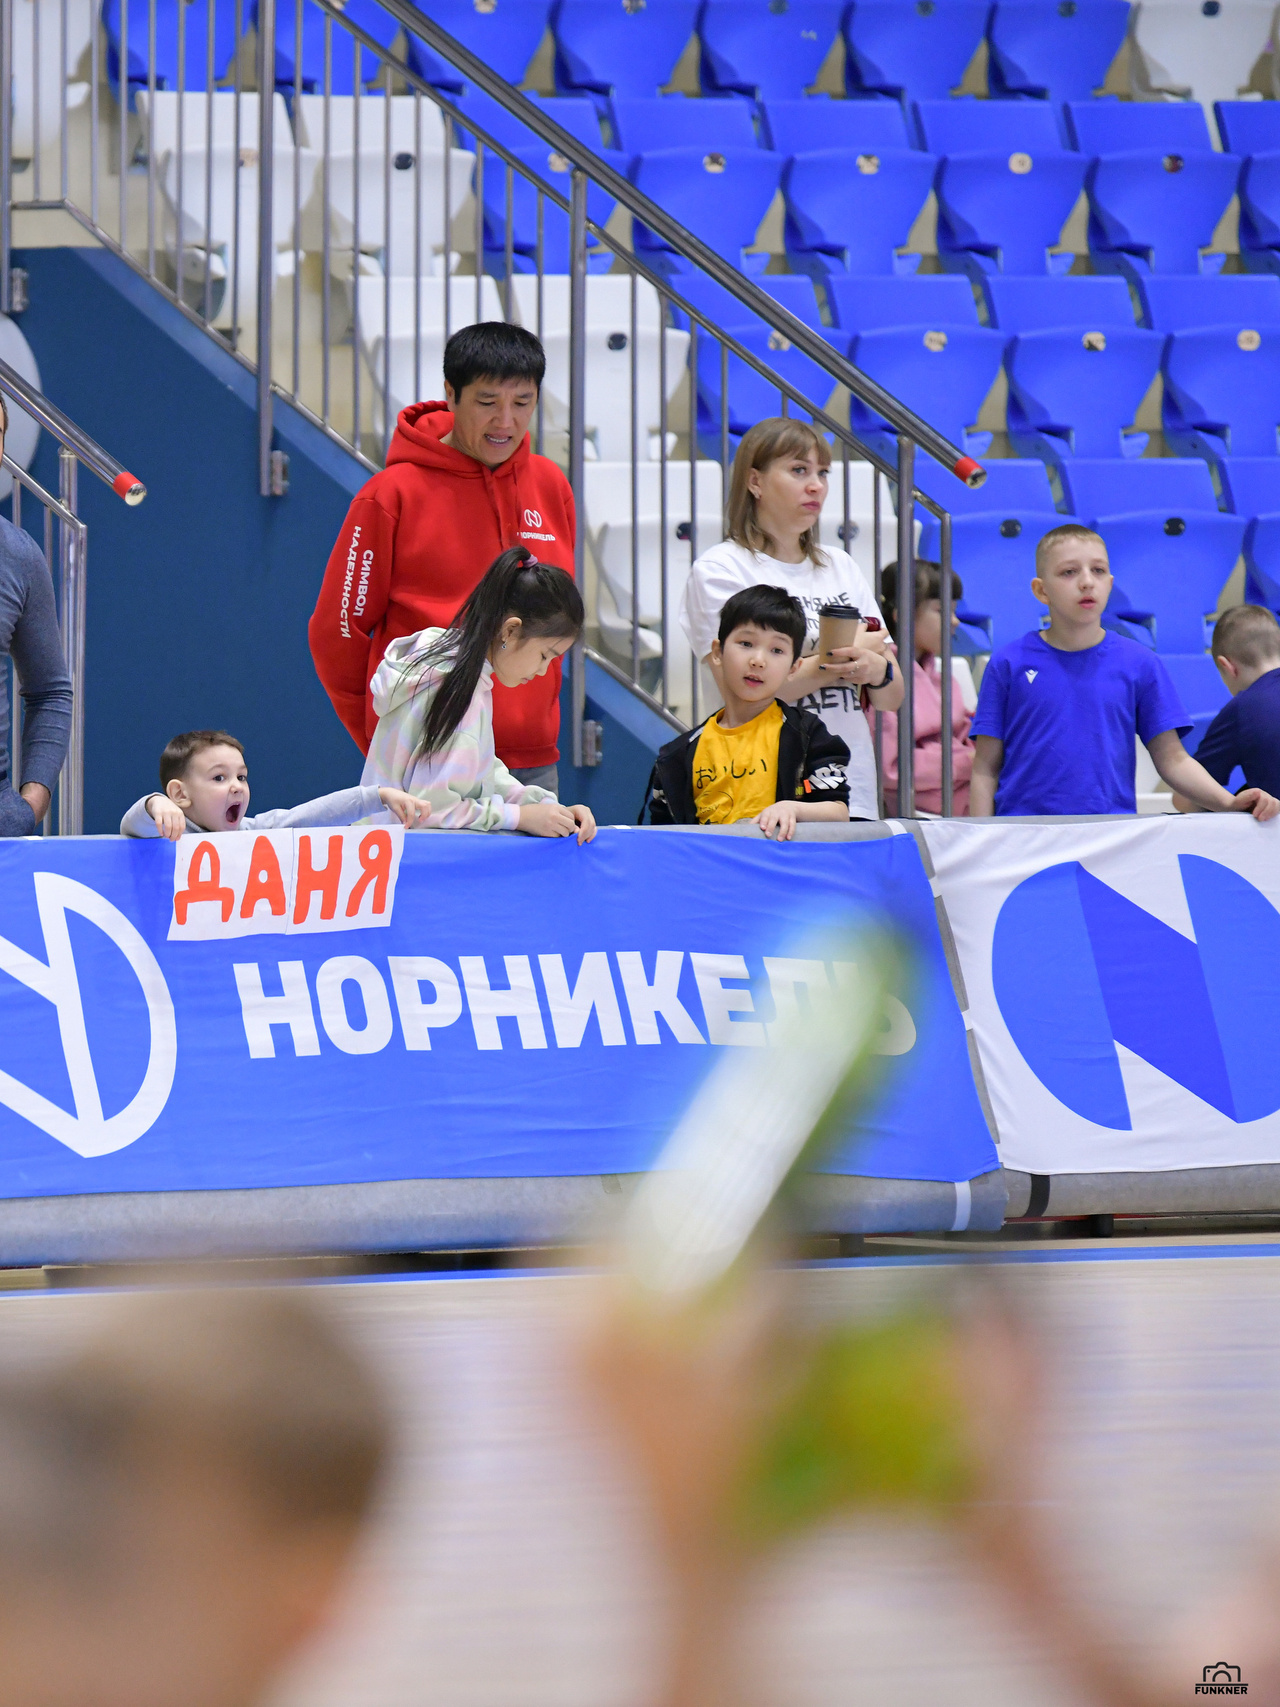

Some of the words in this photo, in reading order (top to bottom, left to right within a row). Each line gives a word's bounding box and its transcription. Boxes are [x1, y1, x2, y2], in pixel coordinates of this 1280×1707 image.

[340, 525, 361, 638] НАДЕЖНОСТИ
[353, 549, 374, 616] СИМВОЛ
[174, 829, 392, 925] ДАНЯ
